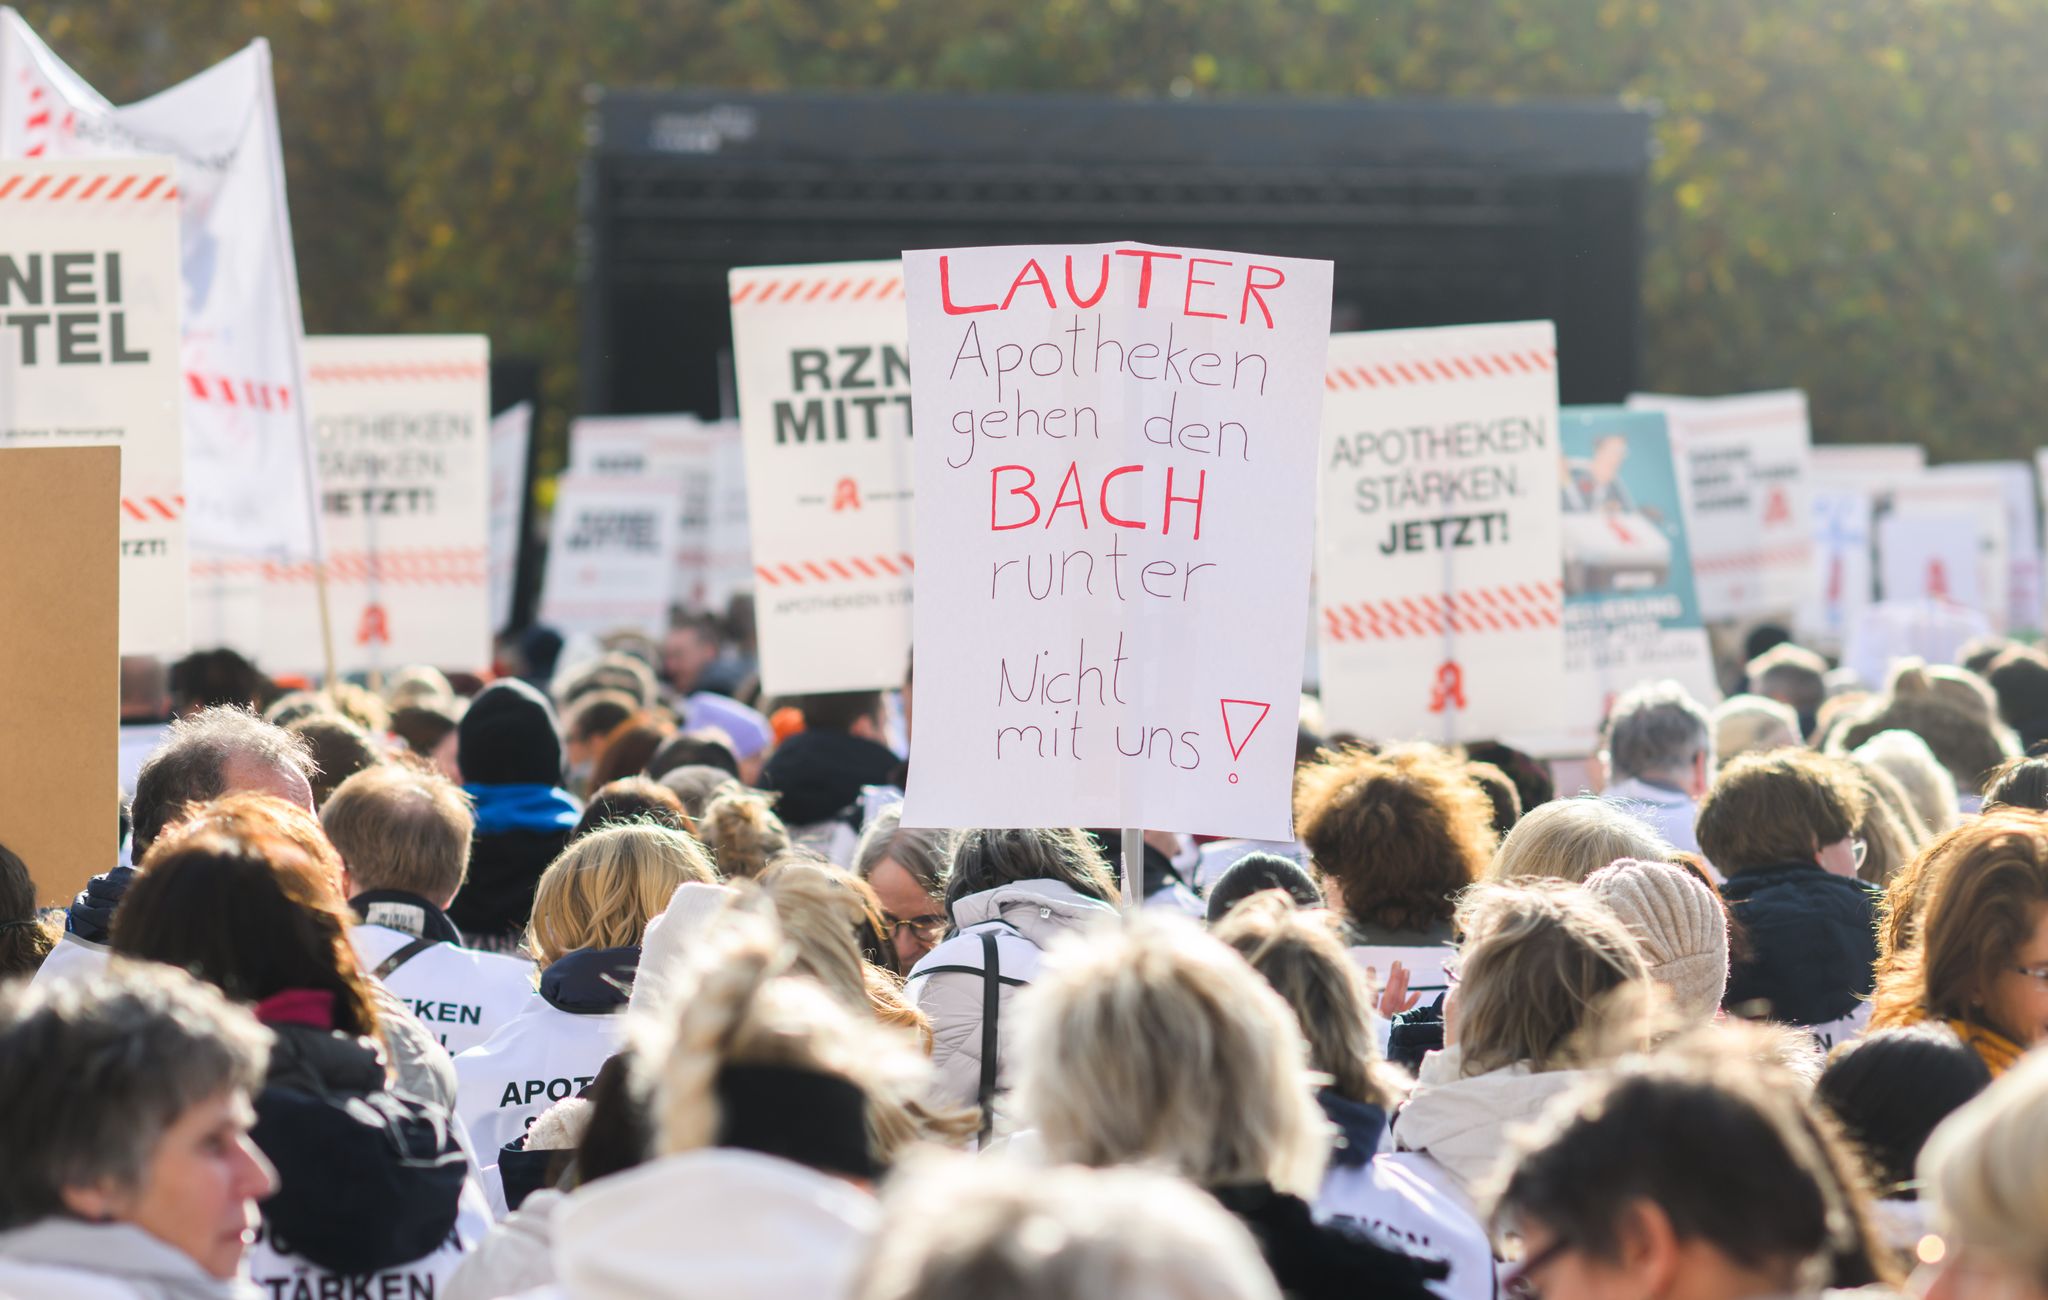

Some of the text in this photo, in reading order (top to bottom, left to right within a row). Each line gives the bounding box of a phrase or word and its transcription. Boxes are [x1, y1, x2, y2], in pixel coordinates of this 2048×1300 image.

[0, 252, 121, 305] NEI
[939, 249, 1286, 329] LAUTER
[0, 312, 150, 366] TEL
[949, 313, 1268, 403] Apotheken
[774, 397, 913, 443] MITT
[947, 389, 1251, 469] gehen den
[1331, 416, 1545, 471] APOTHEKEN
[990, 461, 1206, 541] BACH
[1379, 511, 1509, 555] JETZT!
[992, 532, 1217, 602] runter
[998, 631, 1129, 707] Nicht
[997, 711, 1083, 760] mit
[401, 998, 481, 1025] KEN
[252, 1266, 435, 1300] TÄRKEN
